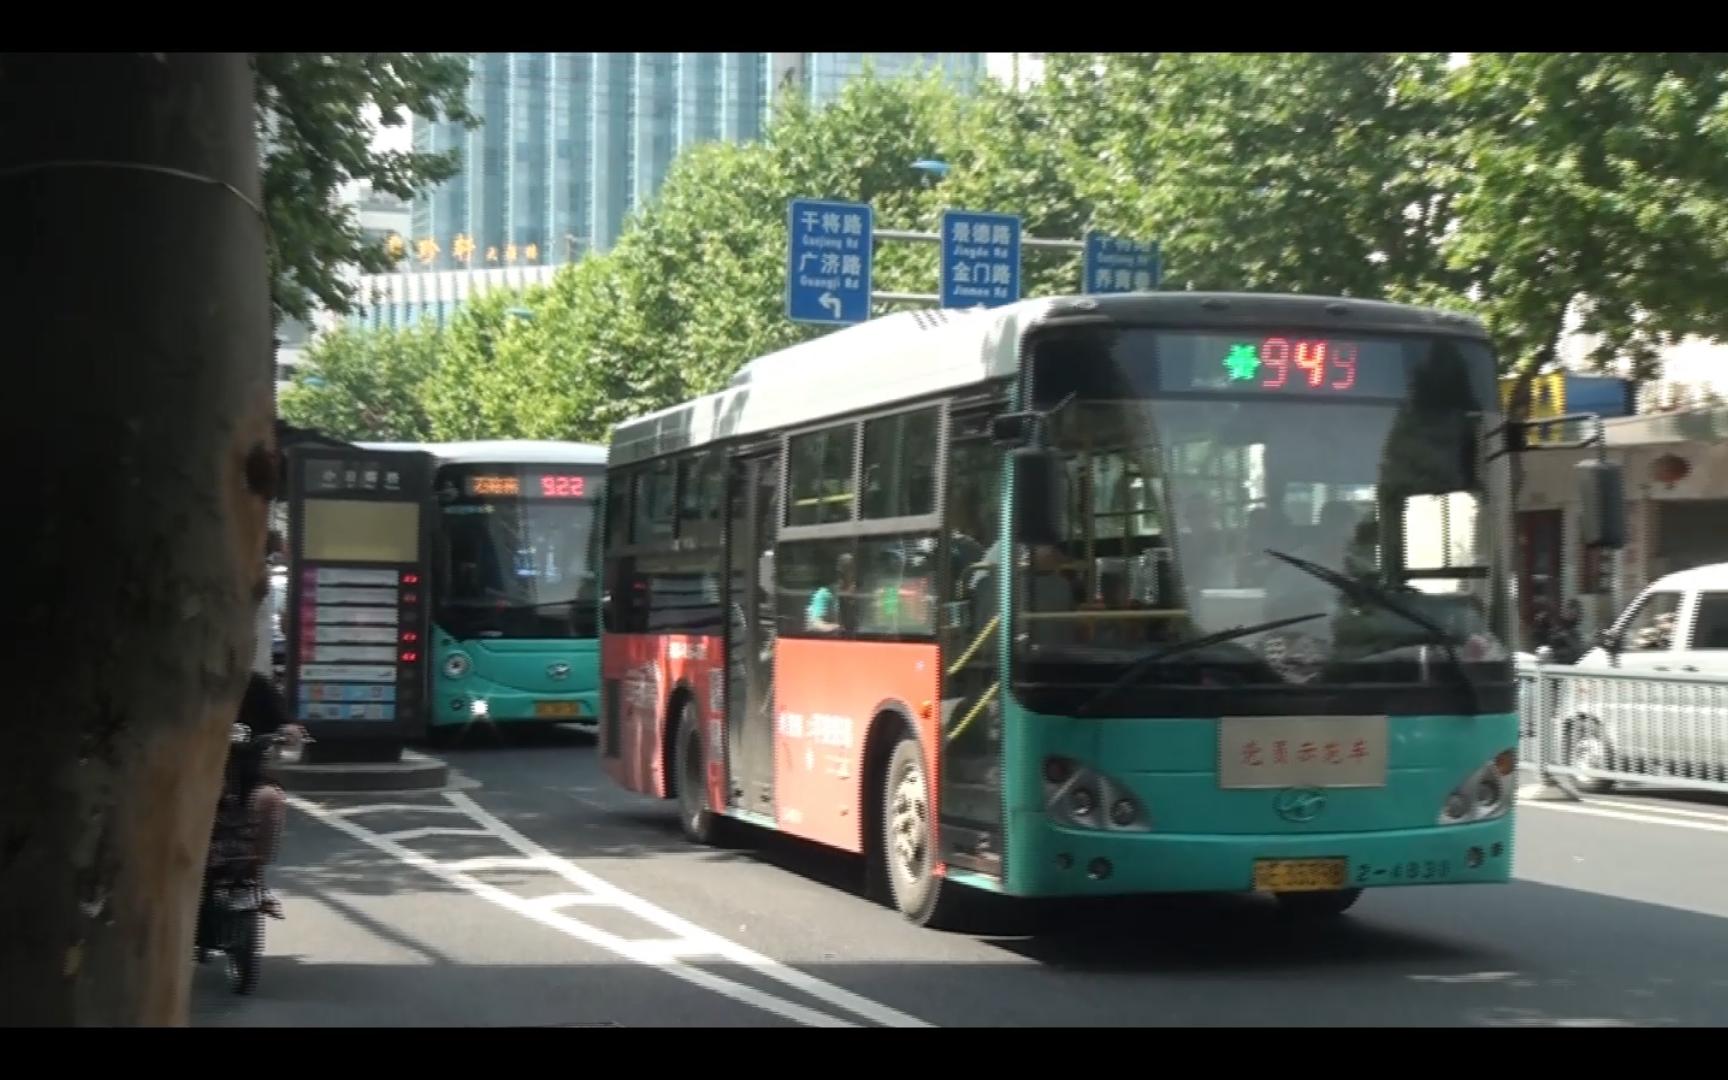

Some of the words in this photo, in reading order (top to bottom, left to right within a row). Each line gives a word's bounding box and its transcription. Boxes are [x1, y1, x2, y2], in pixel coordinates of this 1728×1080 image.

[800, 210, 862, 235] 干将路
[799, 251, 862, 276] 广济路
[952, 261, 1011, 285] 金门路
[1261, 336, 1357, 389] 949
[540, 476, 584, 497] 922
